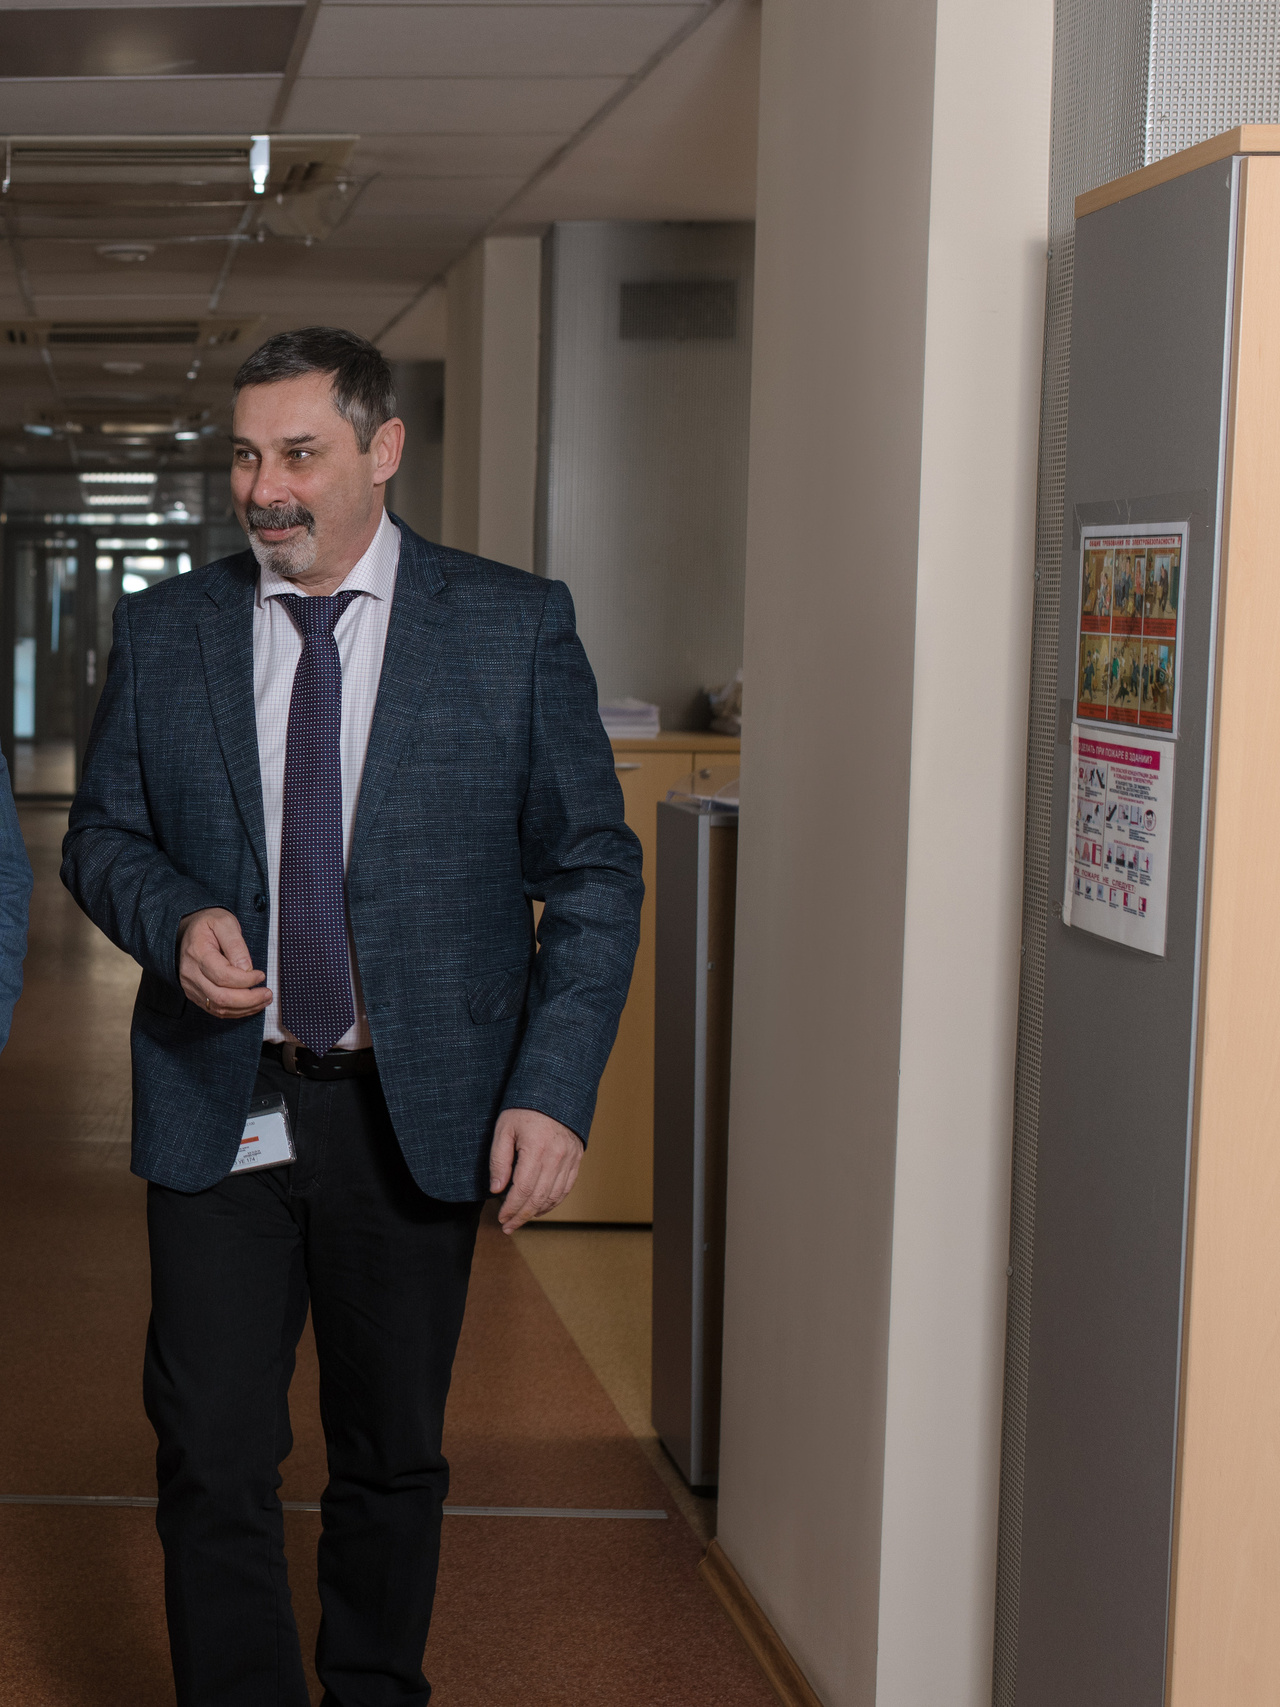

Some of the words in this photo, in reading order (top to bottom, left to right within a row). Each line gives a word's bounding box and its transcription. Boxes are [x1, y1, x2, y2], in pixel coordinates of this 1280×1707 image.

[1080, 743, 1096, 754] ДЕЛАТЬ
[1096, 746, 1105, 755] ПРИ
[1105, 748, 1124, 760] ПОЖАРЕ
[1129, 752, 1153, 765] ЗДАНИИ?
[1081, 868, 1100, 881] ПОЖАРЕ
[1102, 876, 1109, 884] НЕ
